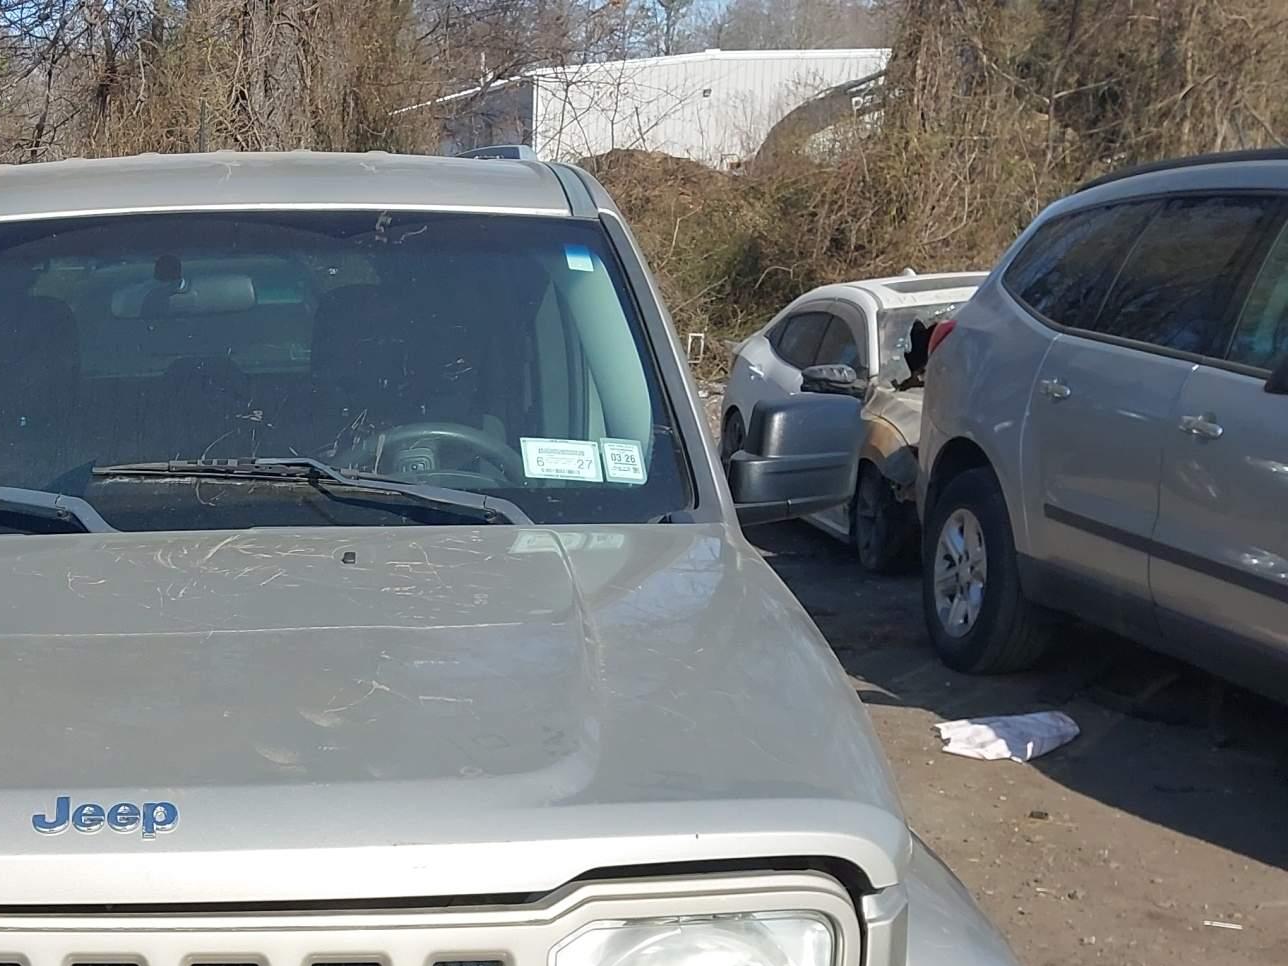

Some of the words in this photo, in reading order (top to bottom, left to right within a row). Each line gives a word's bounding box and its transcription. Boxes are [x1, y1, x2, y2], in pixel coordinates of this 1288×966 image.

[536, 456, 545, 467] 6
[576, 458, 593, 470] 27
[624, 454, 636, 463] 26
[31, 796, 179, 839] Jeep
